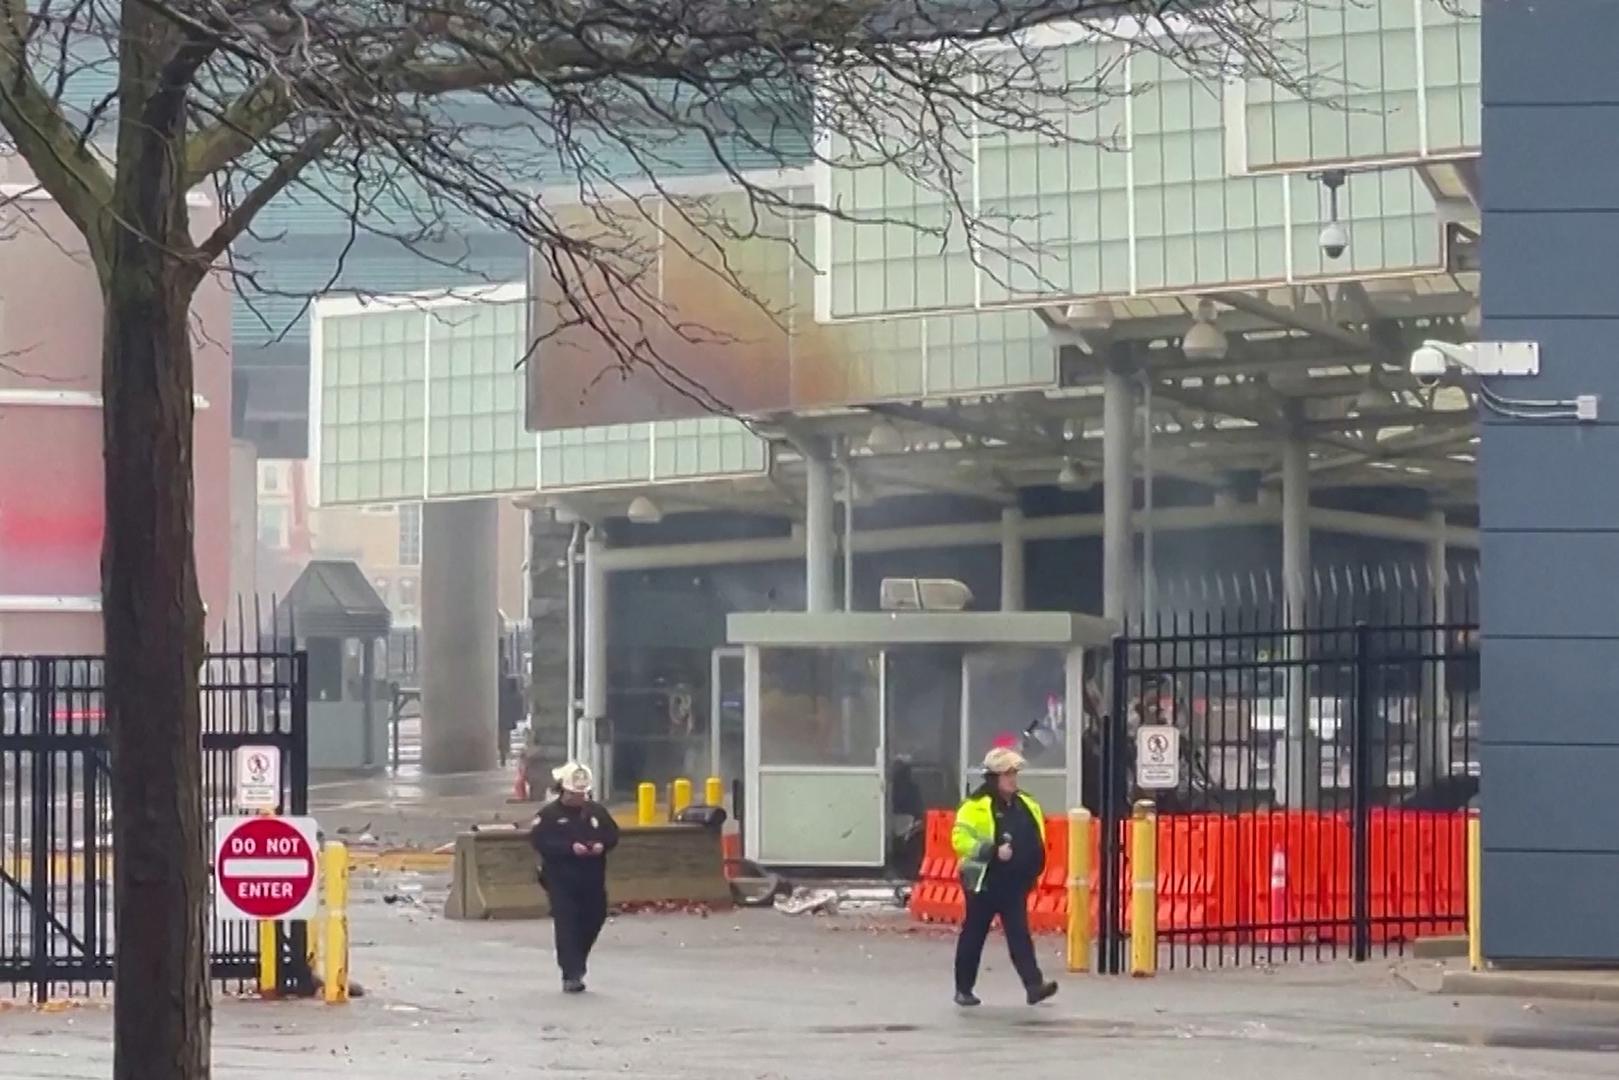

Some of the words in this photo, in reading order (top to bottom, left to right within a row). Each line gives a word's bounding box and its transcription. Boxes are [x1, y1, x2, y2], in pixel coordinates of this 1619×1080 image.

[232, 838, 256, 855] DO
[266, 838, 300, 855] NOT
[238, 882, 293, 899] ENTER
